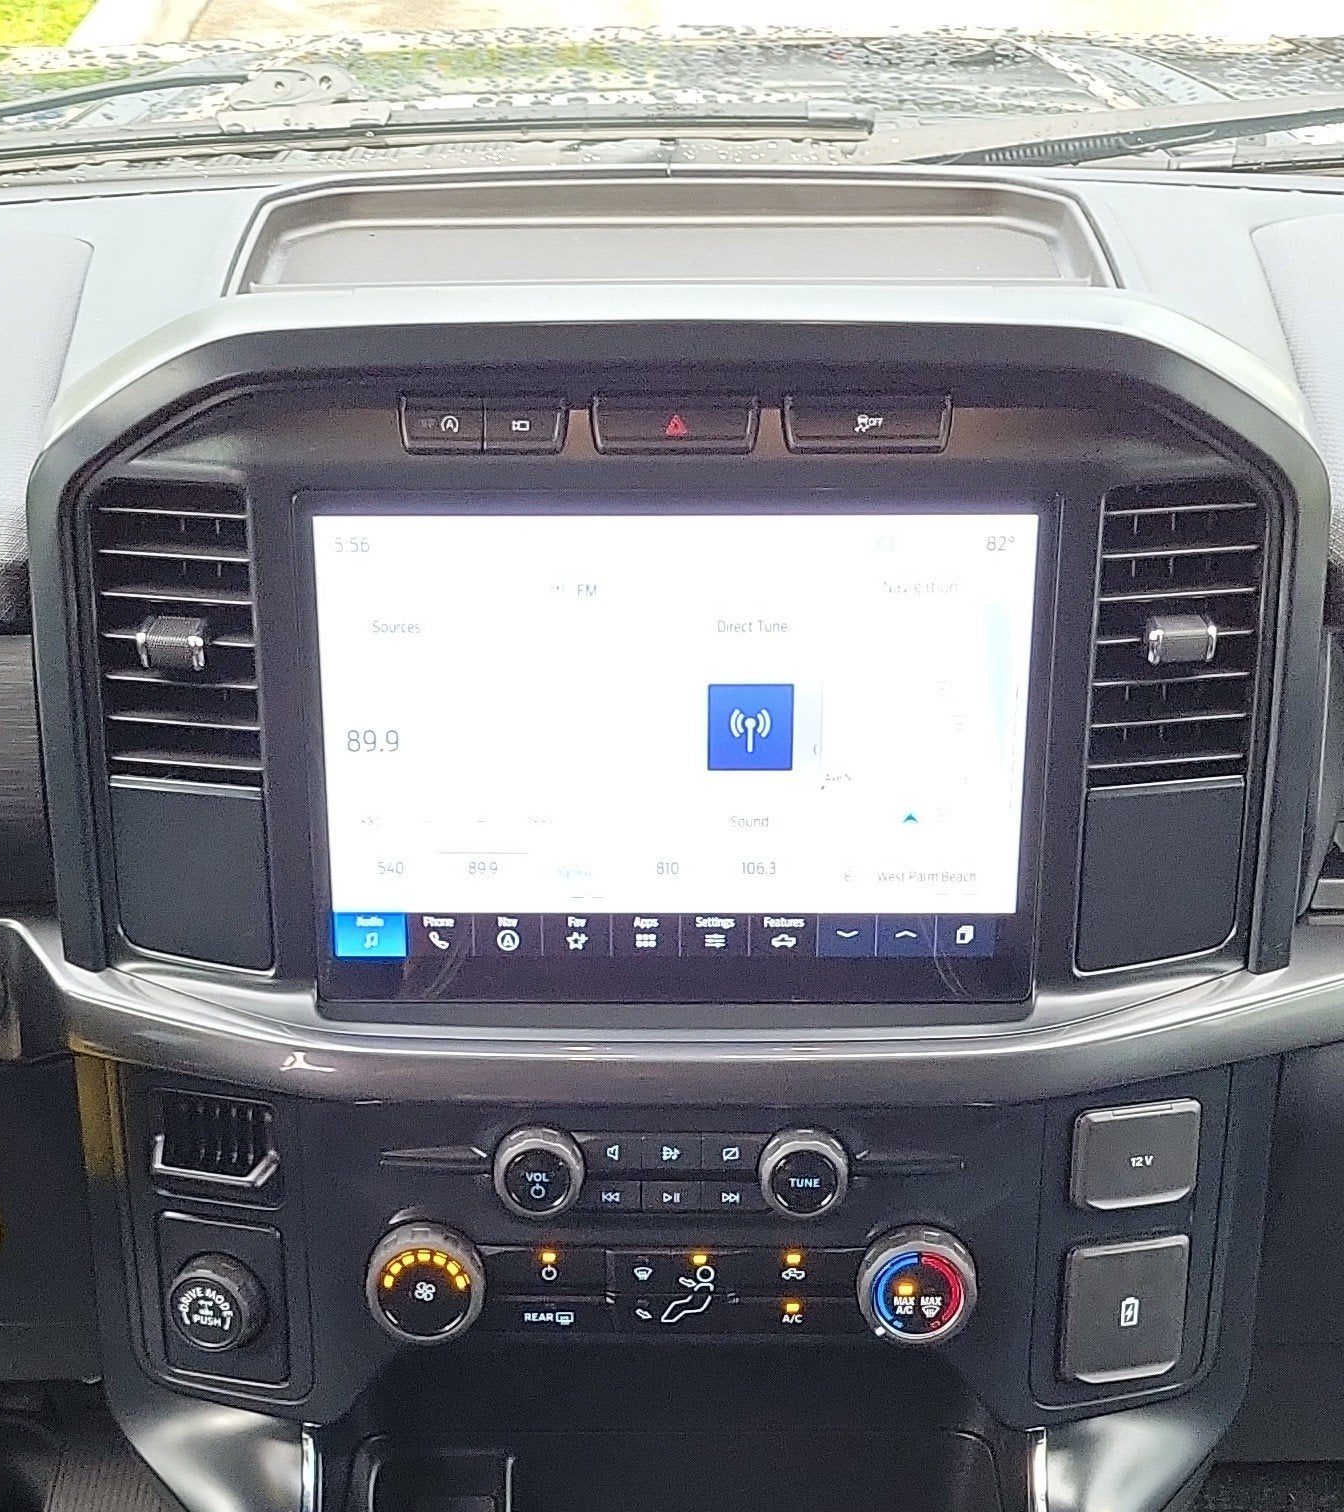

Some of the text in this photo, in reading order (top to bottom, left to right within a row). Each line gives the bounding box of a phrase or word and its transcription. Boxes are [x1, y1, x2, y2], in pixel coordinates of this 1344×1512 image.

[372, 619, 421, 635] Sources
[717, 619, 788, 633] Direct Tune
[347, 729, 399, 752] 89.9
[730, 815, 769, 829] Sound
[377, 860, 404, 876] 540
[656, 860, 680, 876] 810
[741, 860, 777, 876] 106.3
[422, 916, 455, 928] Phone
[633, 916, 659, 929] Apps
[695, 916, 736, 929] Settings
[763, 916, 806, 928] Features
[525, 1171, 550, 1183] VOL
[788, 1177, 821, 1189] TUNE
[178, 1286, 233, 1317] DRIVE MODE
[893, 1296, 916, 1306] MAX
[920, 1296, 943, 1306] MAX
[896, 1305, 914, 1315] A/C
[192, 1313, 222, 1327] PUSH
[524, 1312, 554, 1323] REAR
[782, 1314, 803, 1324] A/C
